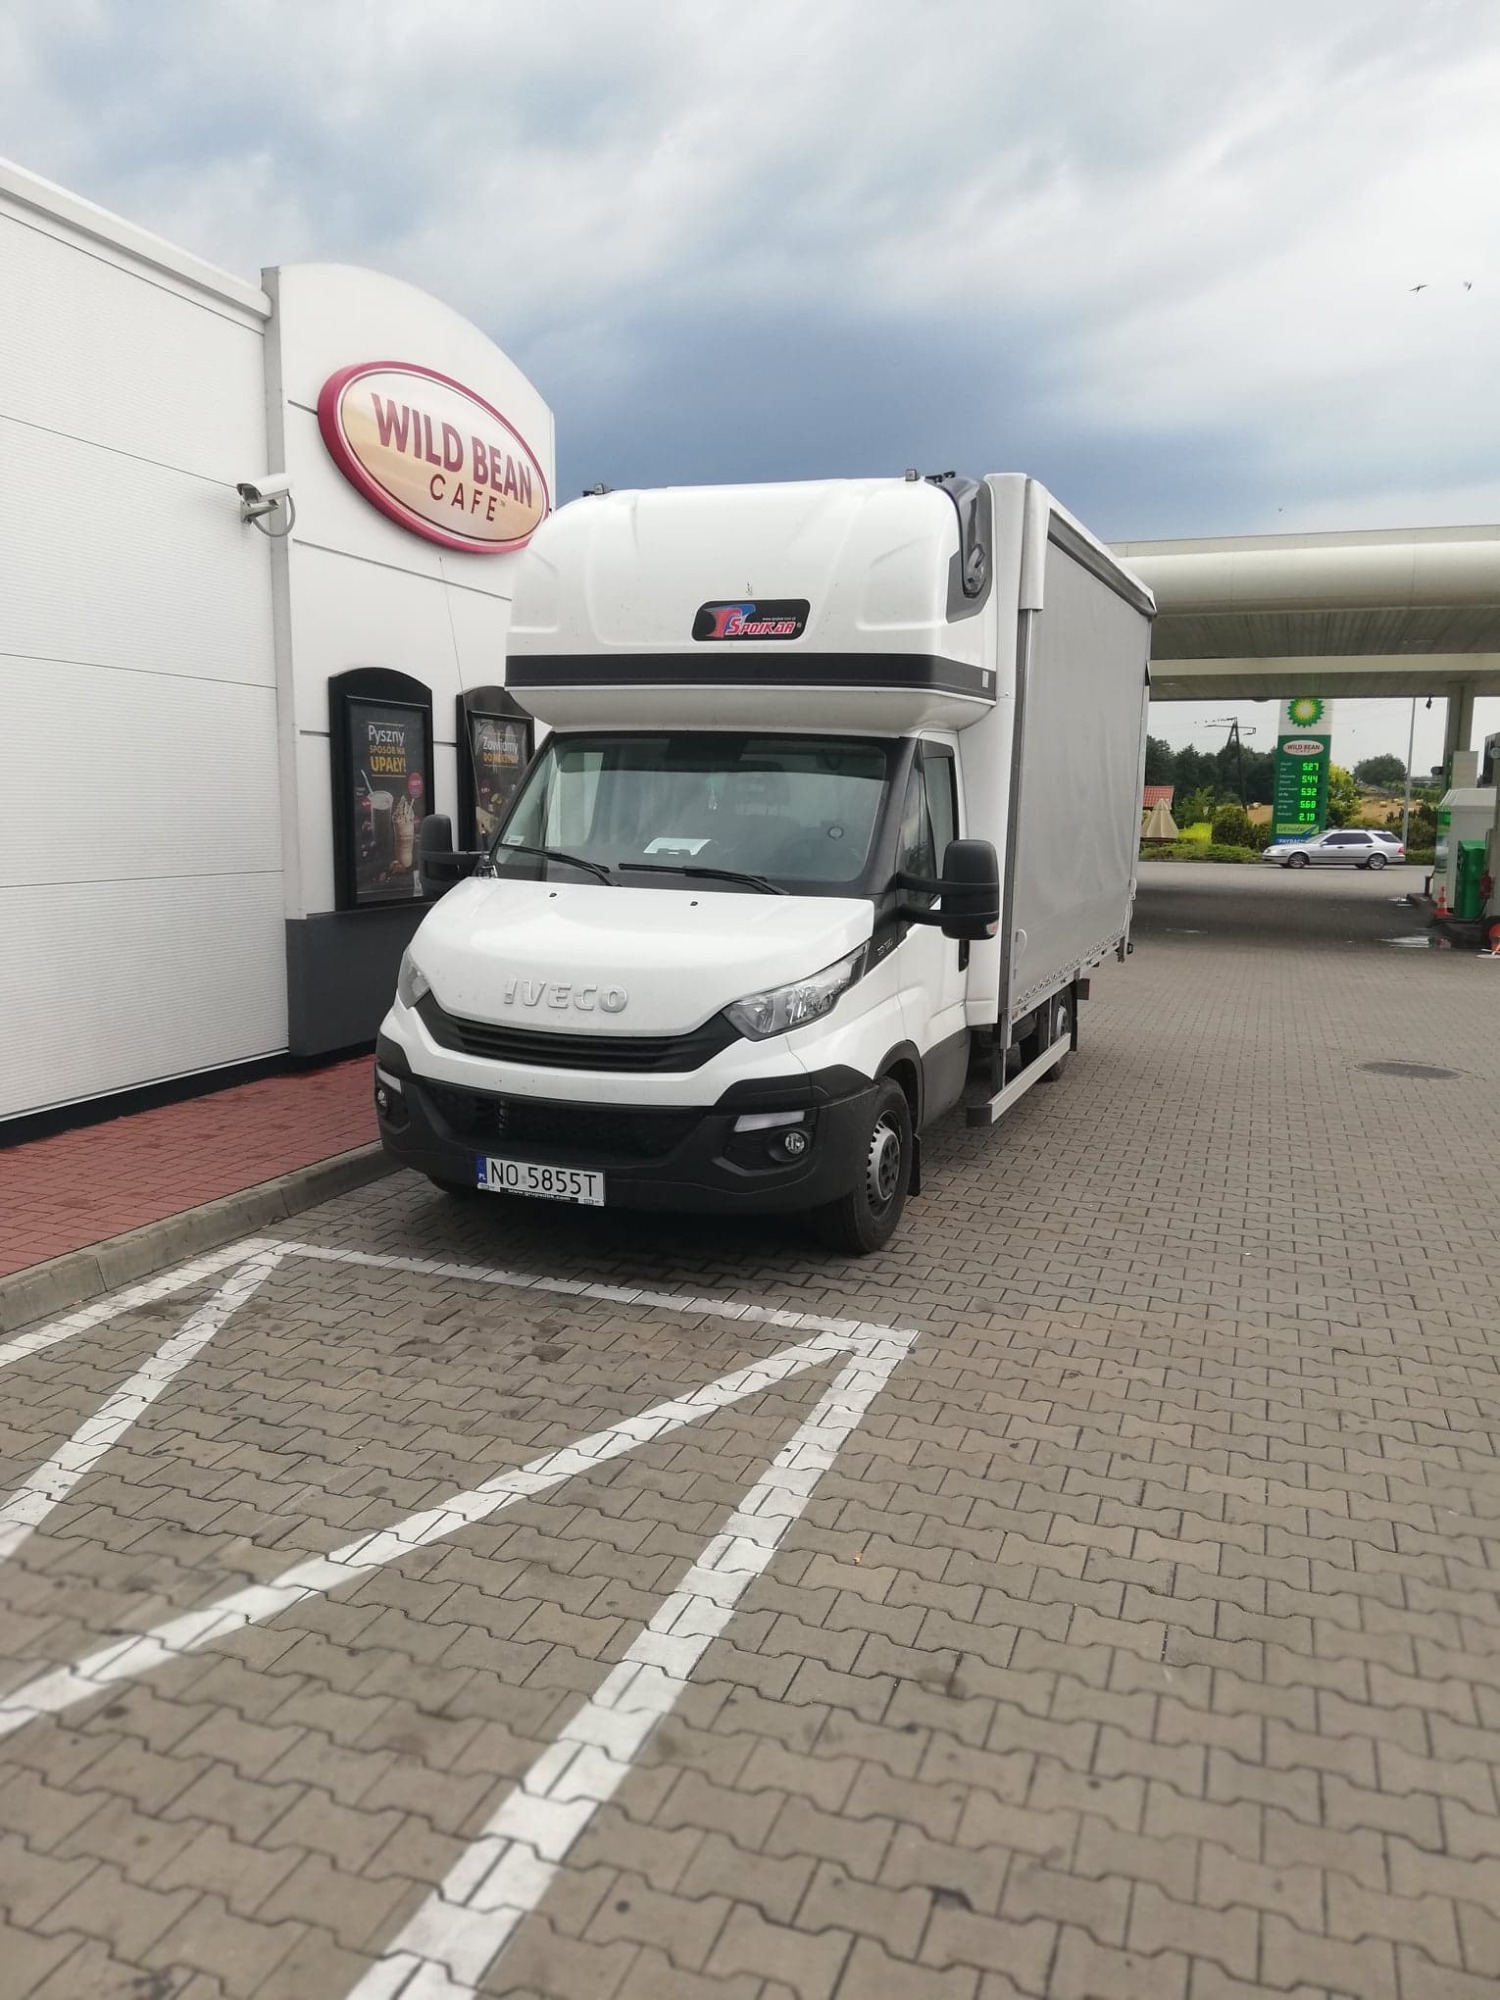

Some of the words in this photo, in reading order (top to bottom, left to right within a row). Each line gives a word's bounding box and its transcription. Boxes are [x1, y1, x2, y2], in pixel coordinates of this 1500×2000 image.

[371, 392, 463, 473] WILD
[471, 436, 533, 508] BEAN
[368, 725, 405, 746] Pyszny
[370, 756, 407, 773] UPAŁY!
[504, 979, 629, 1013] IVECO
[491, 1161, 519, 1186] NO
[528, 1167, 597, 1197] 5855T
